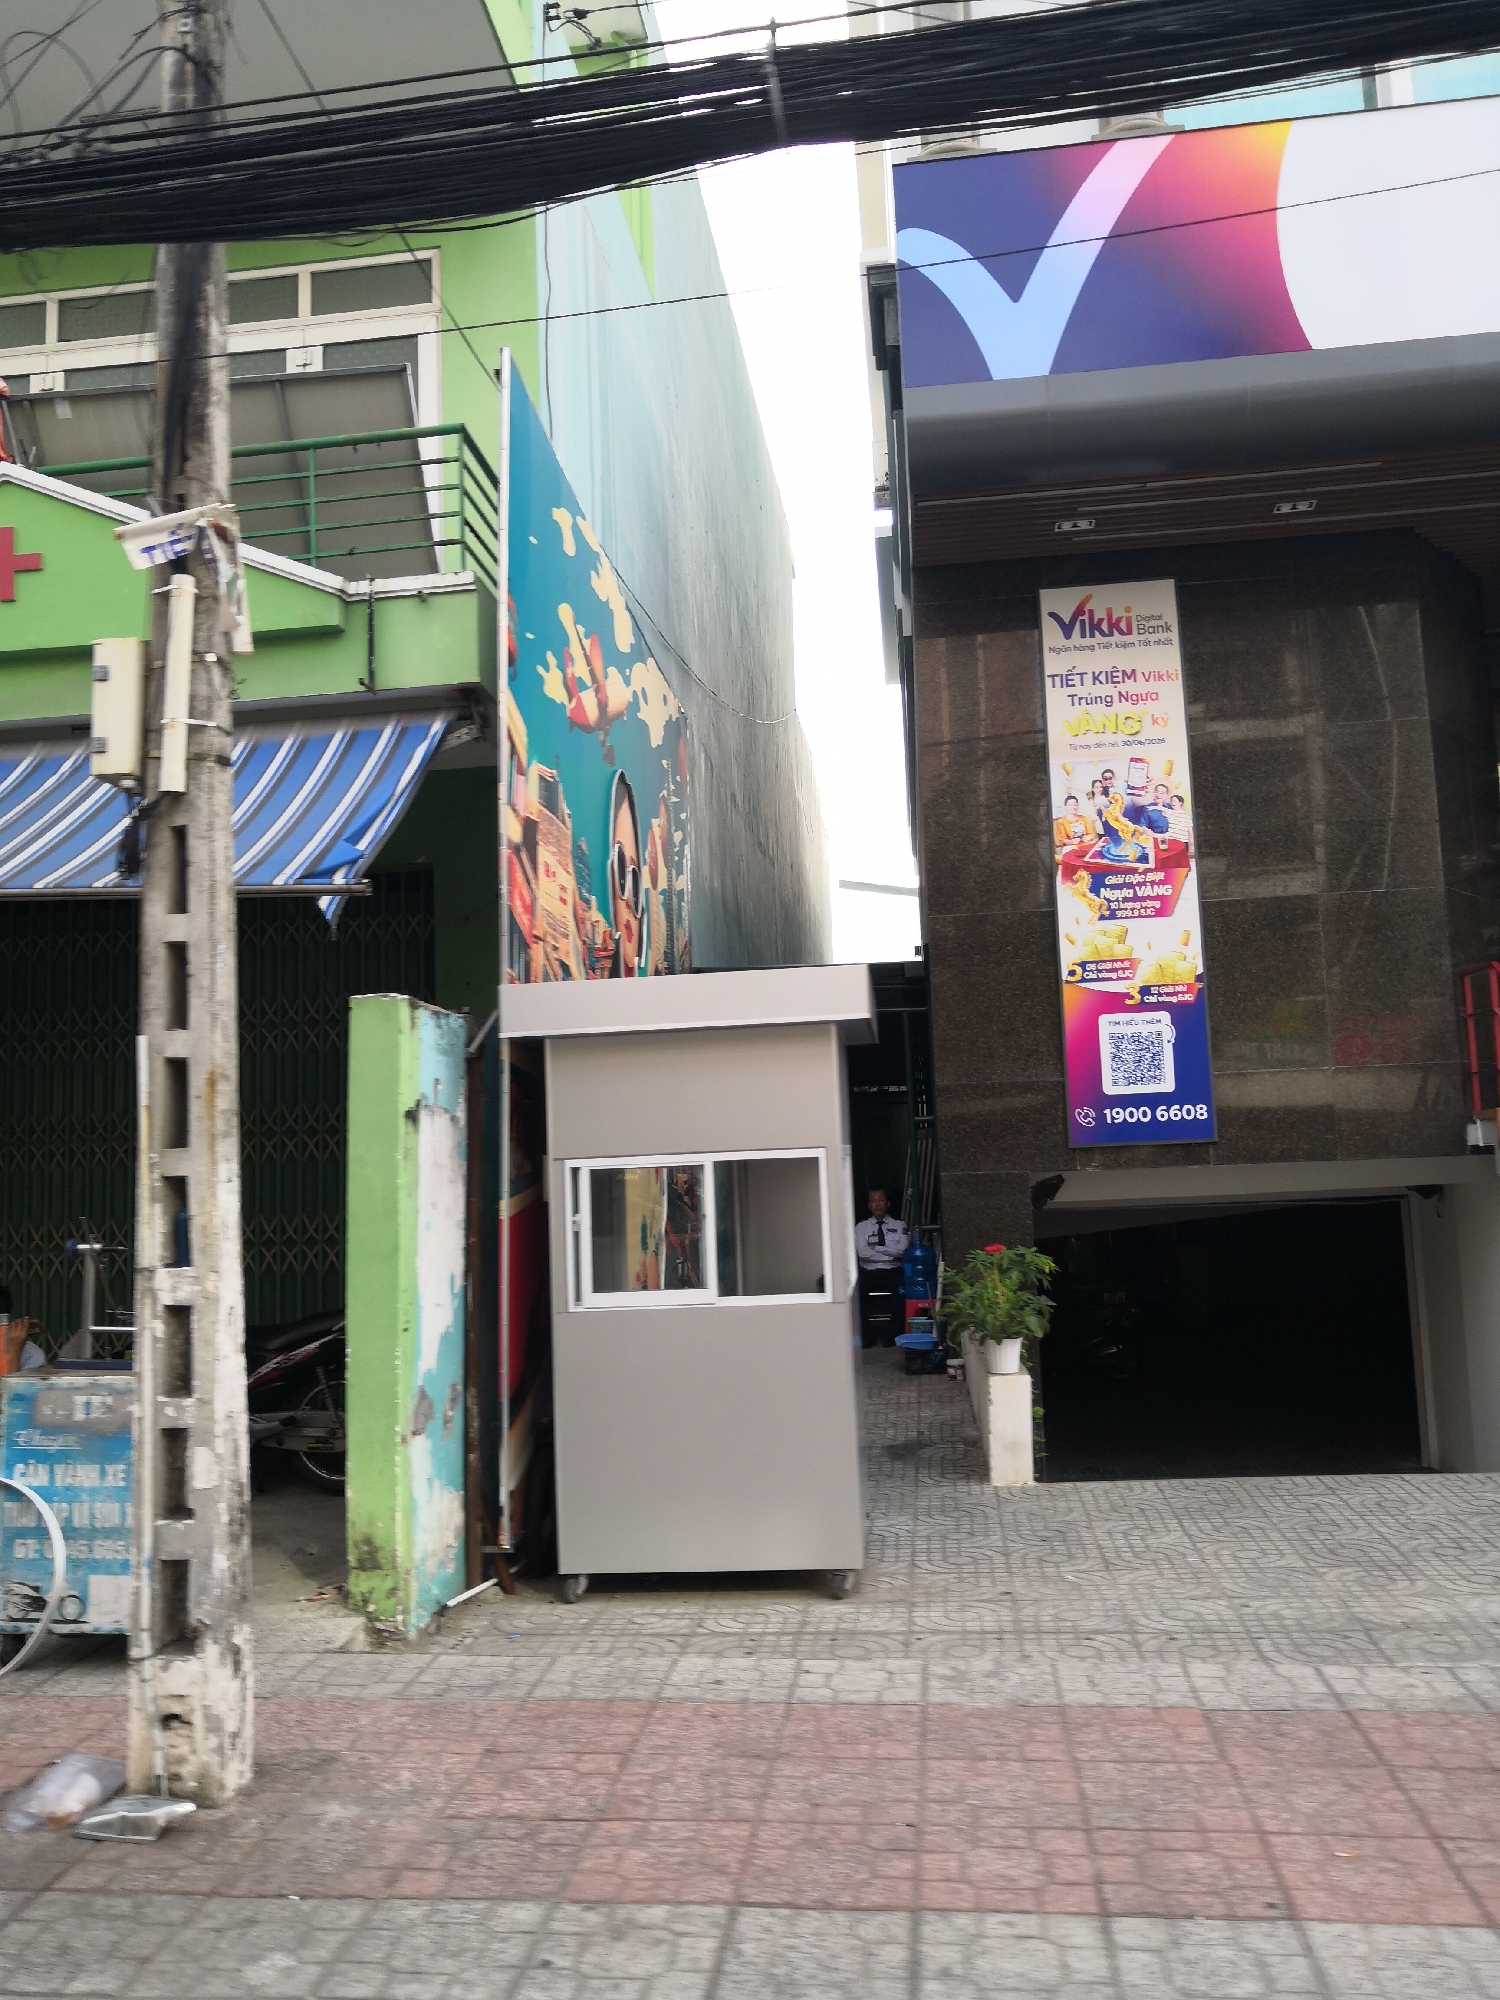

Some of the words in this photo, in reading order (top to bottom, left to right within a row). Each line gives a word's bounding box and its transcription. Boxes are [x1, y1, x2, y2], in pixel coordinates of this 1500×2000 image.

[1047, 594, 1133, 640] Vikki
[1136, 613, 1163, 623] Digital
[1136, 622, 1173, 635] Bank
[1047, 666, 1088, 688] TIẾT
[1092, 666, 1137, 688] KIỆM
[1141, 669, 1179, 683] Vikki
[1067, 693, 1114, 707] Trúng
[1118, 691, 1159, 705] Ngựa
[1062, 709, 1143, 737] VÀNG
[1100, 887, 1134, 901] Ngựa
[1136, 883, 1173, 897] VÀNG
[1066, 959, 1083, 982] 5
[1124, 983, 1141, 1005] 3
[1103, 1107, 1152, 1124] 1900
[1155, 1104, 1208, 1121] 6608
